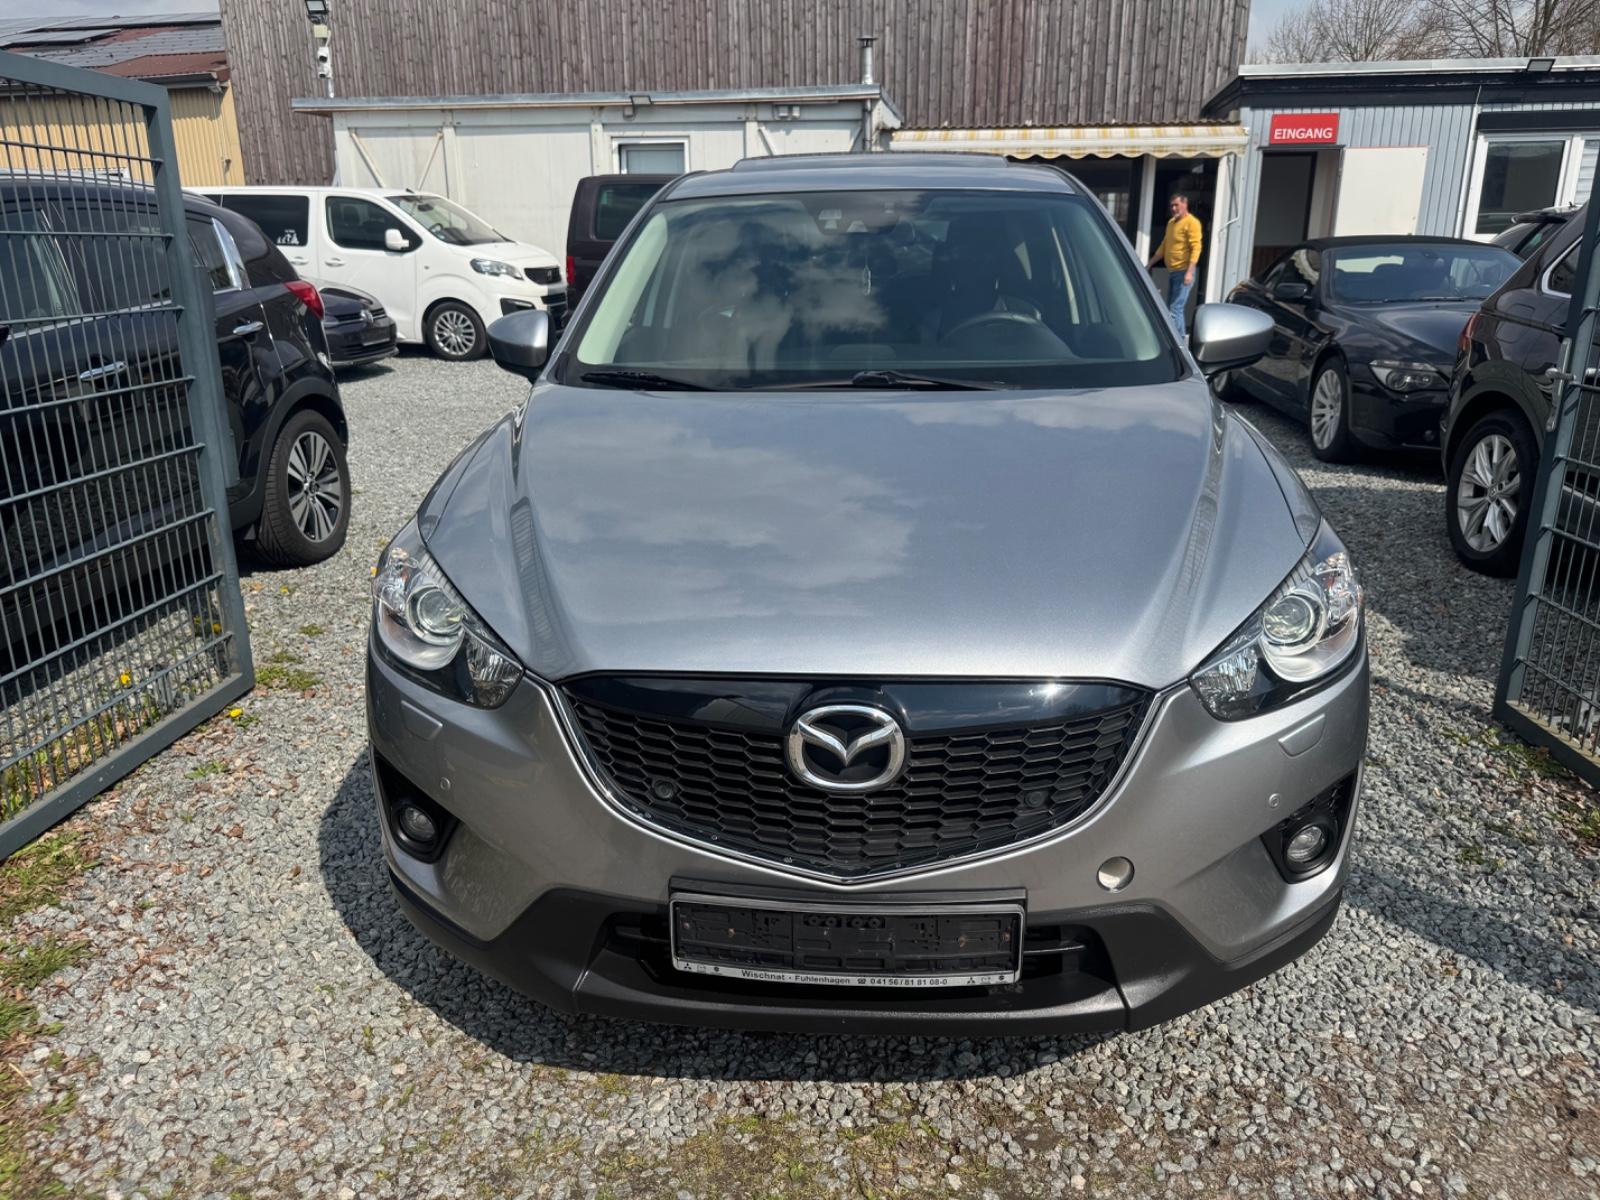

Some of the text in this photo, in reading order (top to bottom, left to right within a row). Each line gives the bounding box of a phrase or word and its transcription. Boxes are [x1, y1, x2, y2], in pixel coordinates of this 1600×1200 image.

[1274, 127, 1333, 140] EINGANG
[742, 969, 785, 981] Wischnat
[795, 975, 850, 985] Fuhlenhagen
